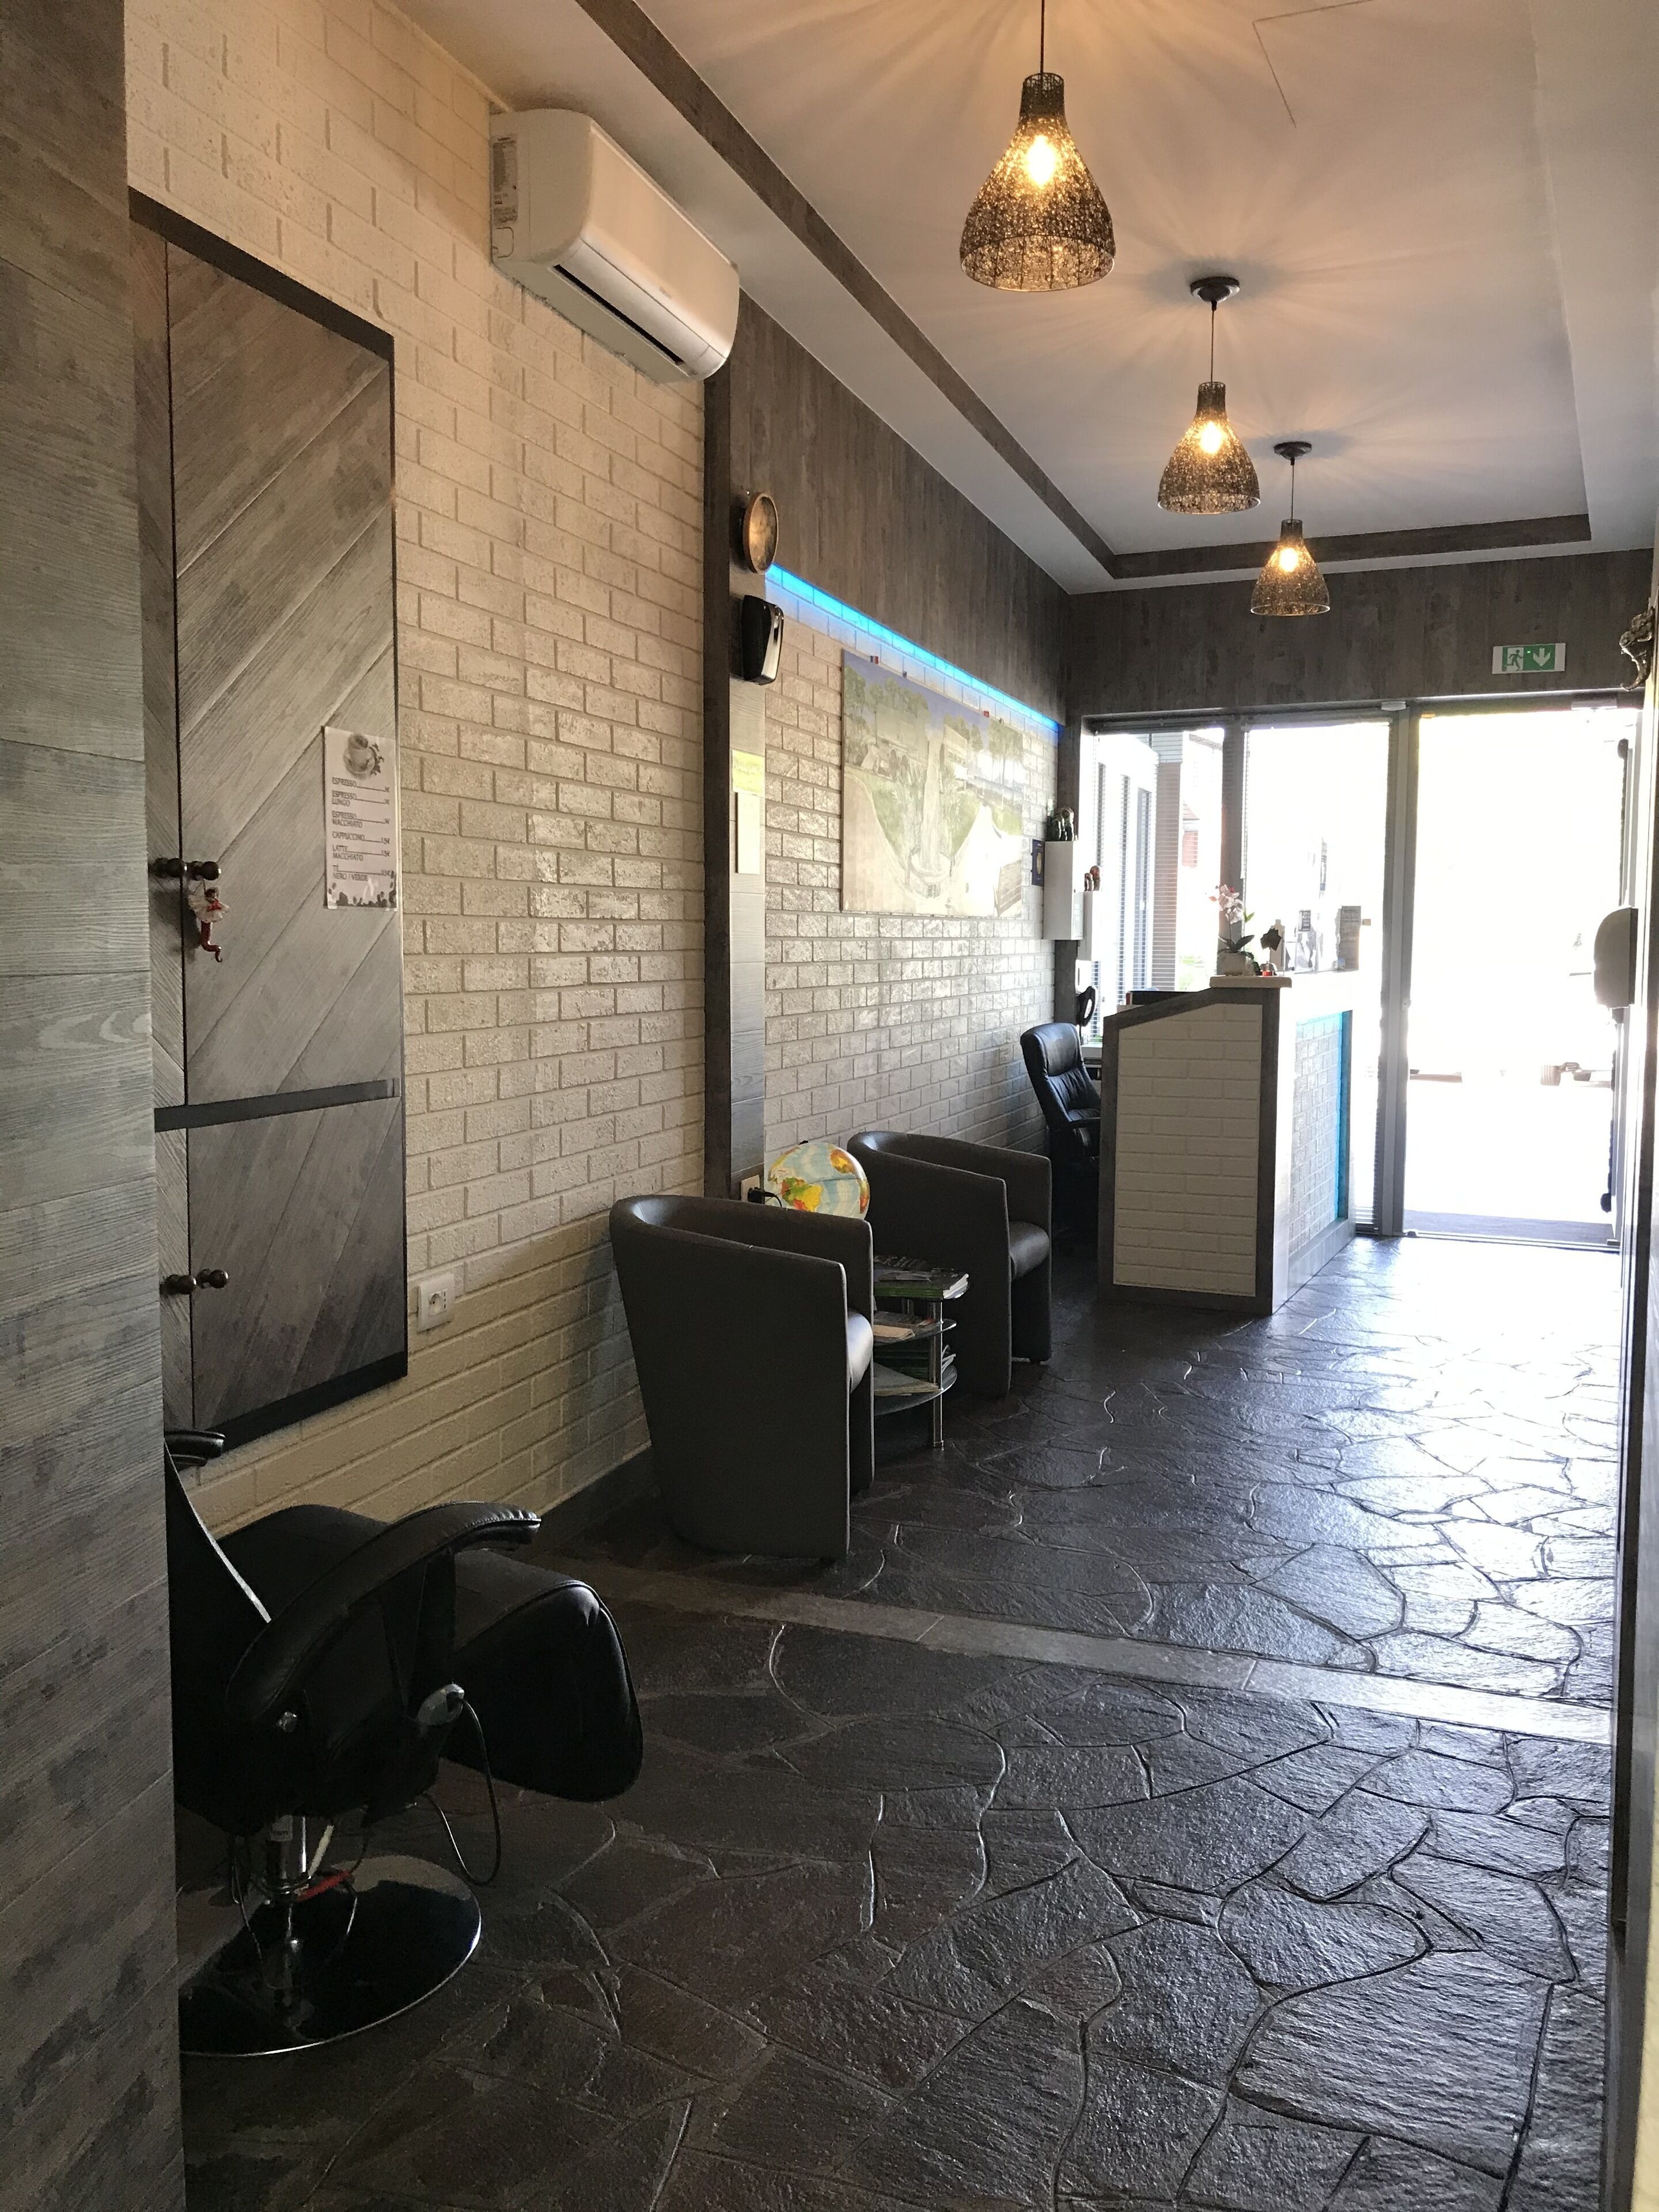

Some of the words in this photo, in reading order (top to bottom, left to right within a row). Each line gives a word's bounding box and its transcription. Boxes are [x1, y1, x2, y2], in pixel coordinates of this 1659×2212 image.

[332, 777, 357, 787] ESPRESSO
[332, 790, 357, 800] ESPRESSO
[332, 798, 350, 807] LUNGO
[332, 810, 357, 820] ESPRESSO
[332, 819, 362, 828] MACCHIATO
[332, 831, 365, 841] CAPPUCCINO
[332, 853, 363, 861] MACCHIATO
